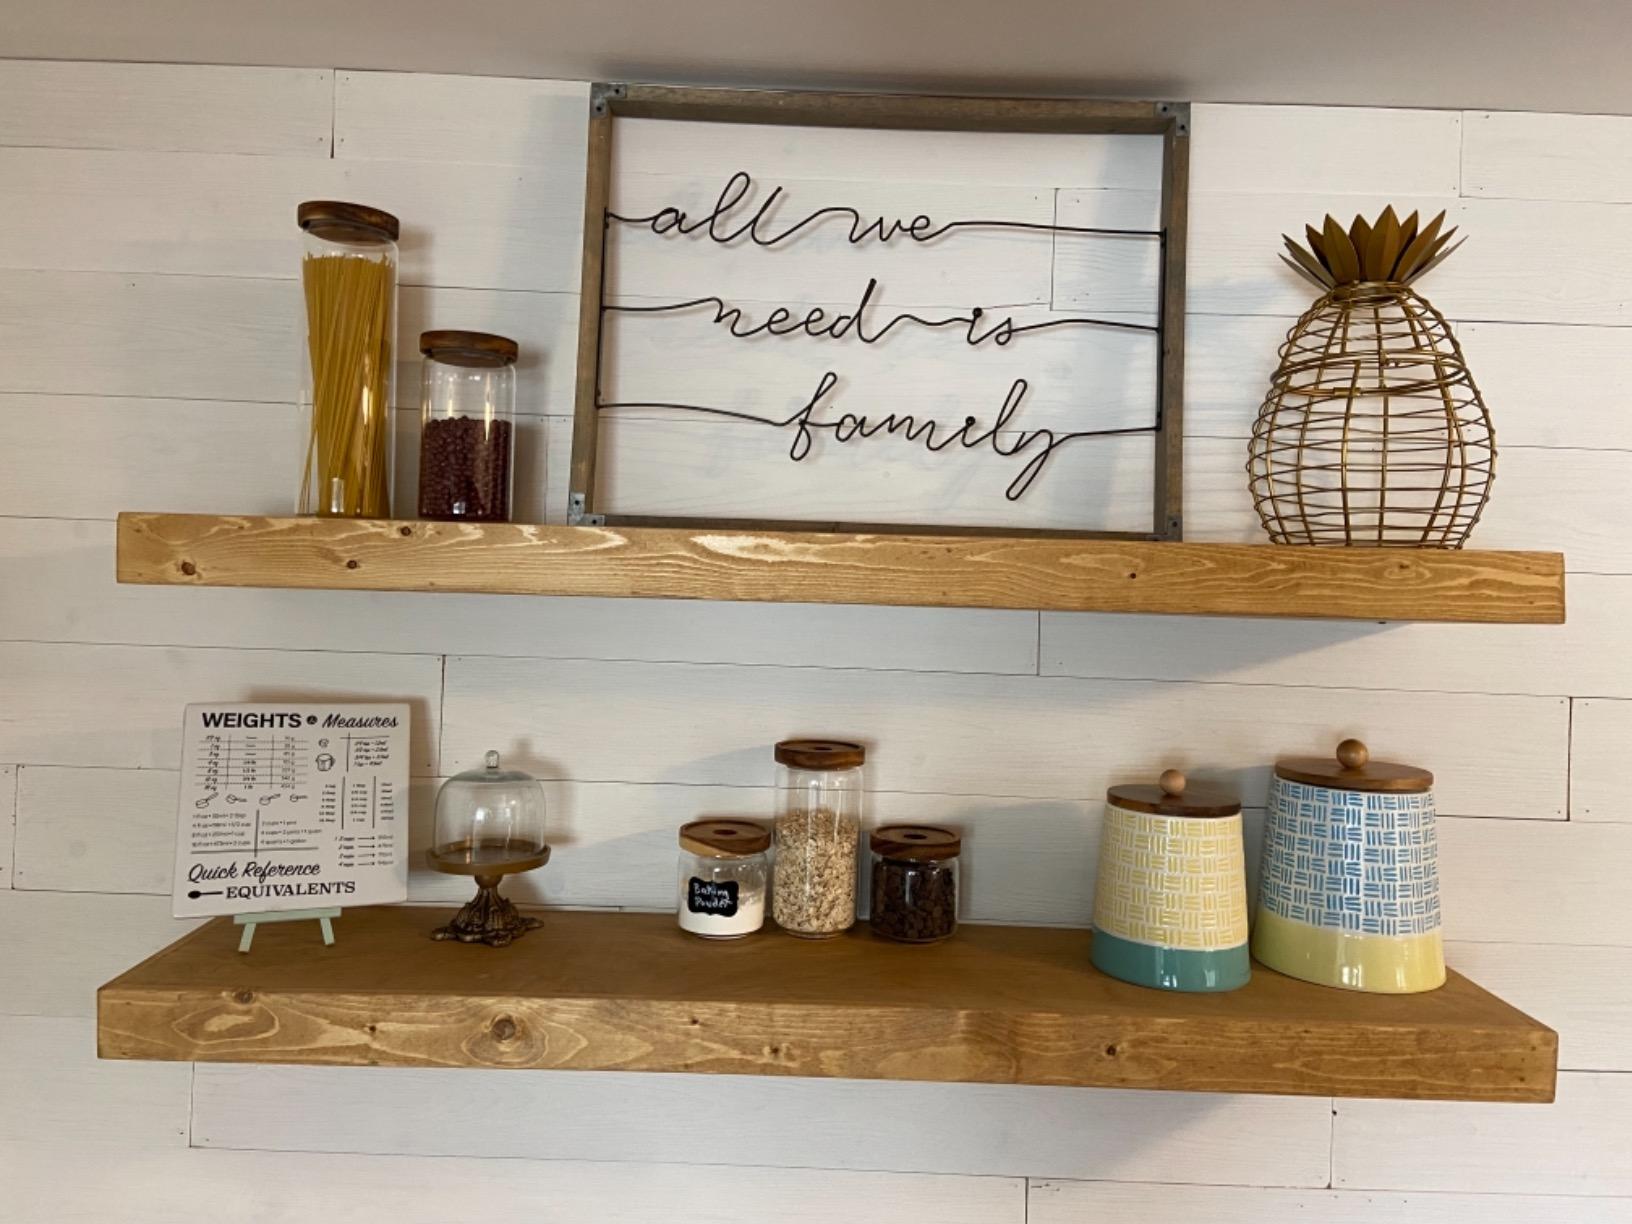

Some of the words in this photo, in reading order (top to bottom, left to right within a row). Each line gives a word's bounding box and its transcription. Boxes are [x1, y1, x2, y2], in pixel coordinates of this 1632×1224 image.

[651, 172, 792, 245] all
[834, 207, 949, 243] we
[713, 278, 885, 342] need
[964, 308, 1015, 346] is
[786, 372, 1058, 501] family
[202, 712, 301, 729] WEIGHTS
[322, 713, 399, 729] Measures
[187, 862, 238, 883] Quick
[242, 861, 321, 883] Reference
[226, 881, 356, 899] EQUIVALENTS
[693, 882, 730, 900] Baking
